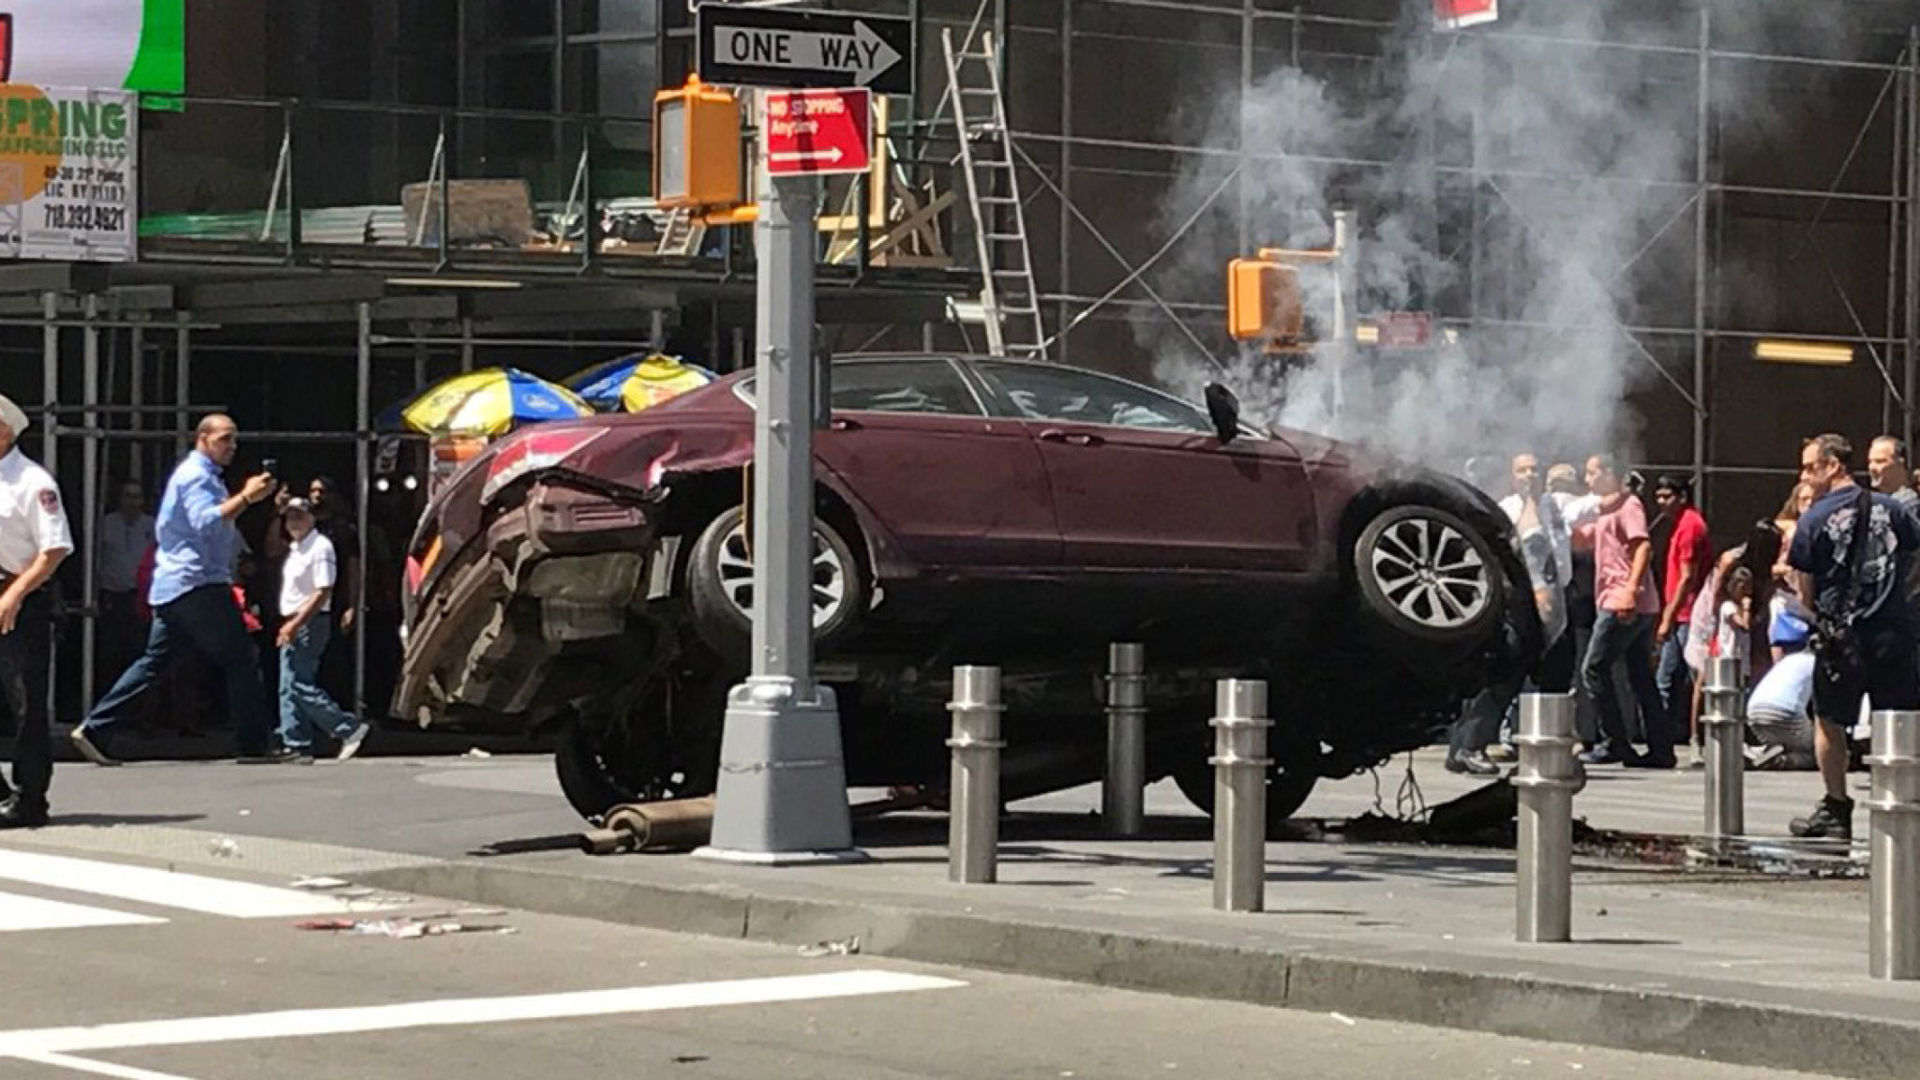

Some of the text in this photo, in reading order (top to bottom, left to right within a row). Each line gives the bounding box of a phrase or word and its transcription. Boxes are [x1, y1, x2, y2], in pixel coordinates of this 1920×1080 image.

[731, 31, 881, 70] ONE WAY
[0, 98, 127, 140] PRING
[770, 97, 845, 117] NO STOPPING
[770, 120, 819, 139] Anytime
